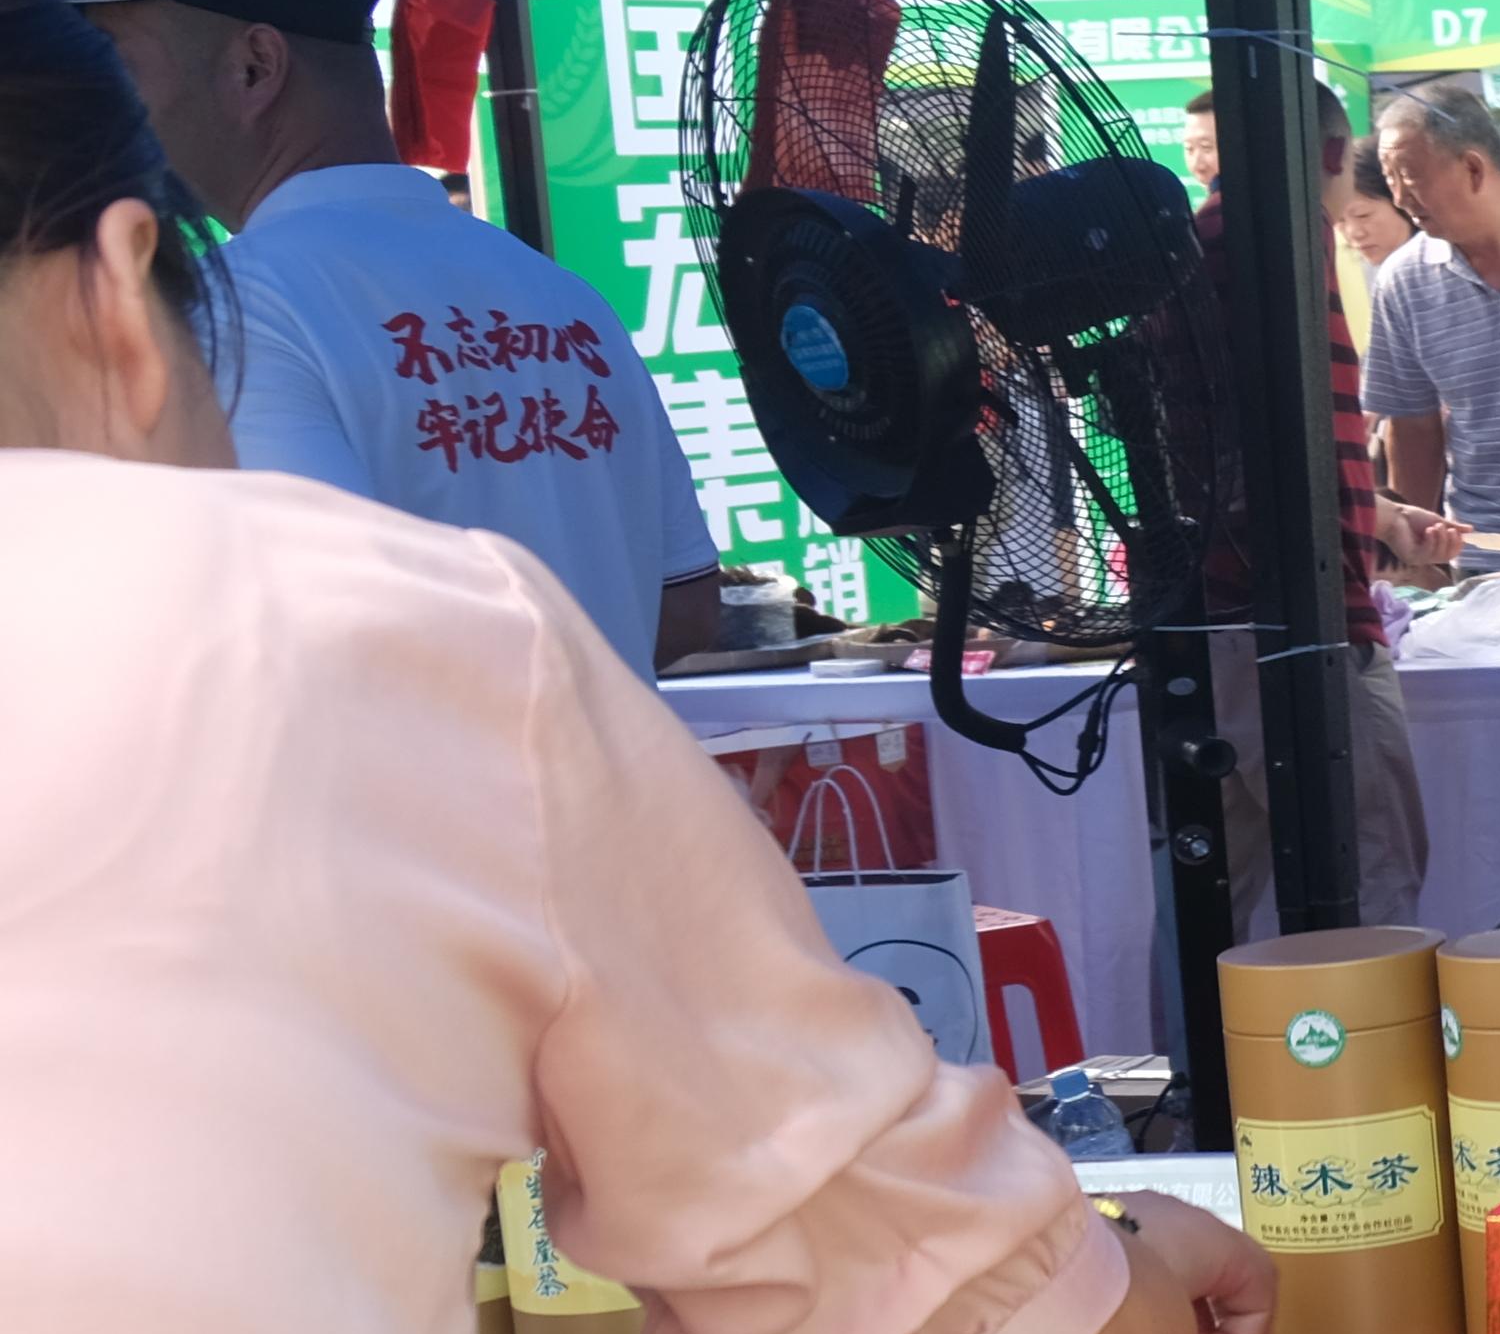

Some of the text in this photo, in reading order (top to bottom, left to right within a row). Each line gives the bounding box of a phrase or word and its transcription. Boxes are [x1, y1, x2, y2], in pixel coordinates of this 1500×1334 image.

[1432, 8, 1488, 46] D7
[381, 305, 611, 385] 不忘初心
[417, 383, 620, 474] 牢记使命
[1250, 1153, 1419, 1196] 辣木茶
